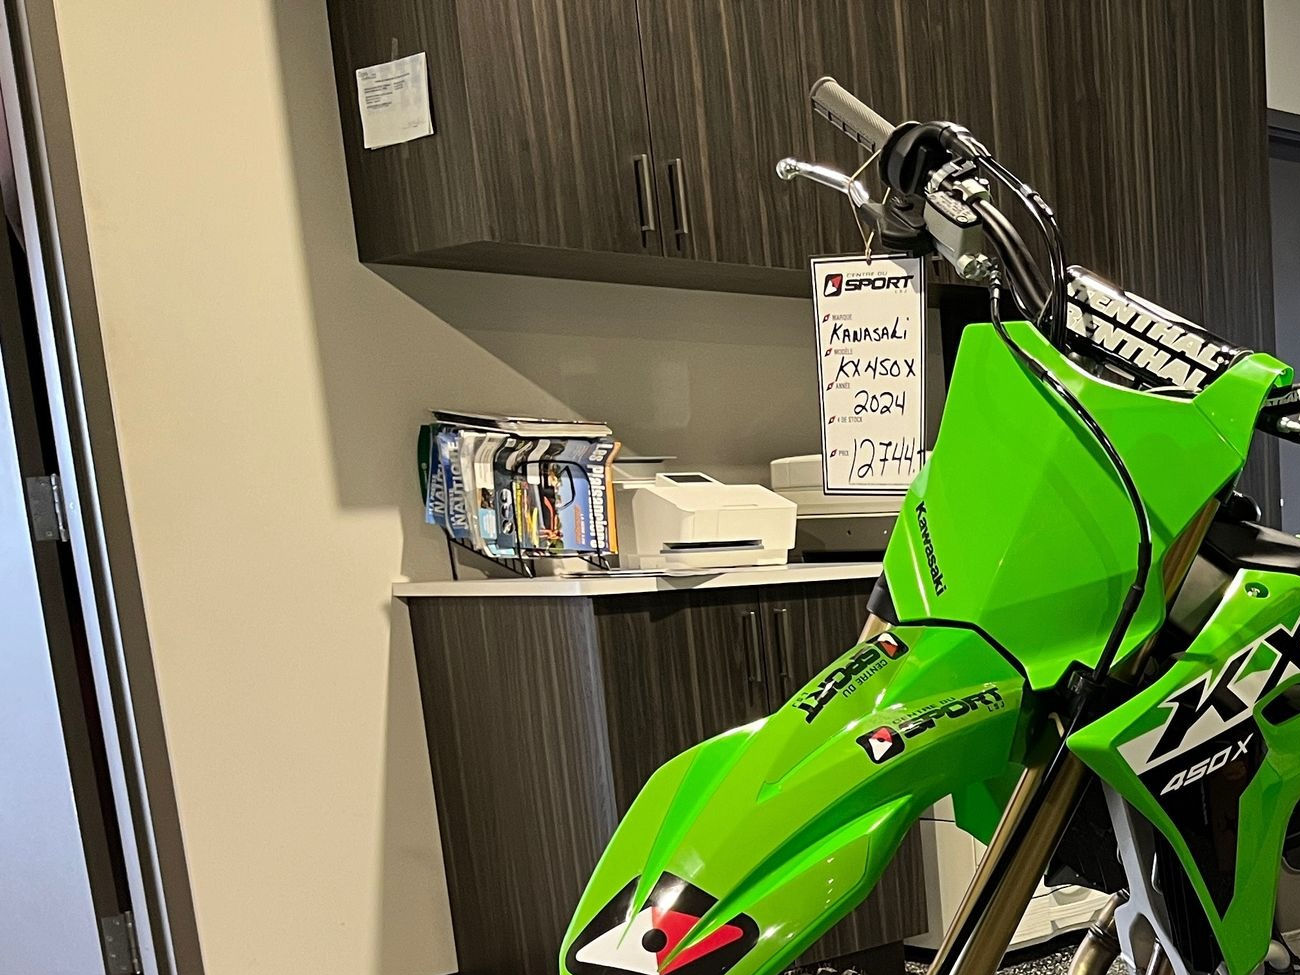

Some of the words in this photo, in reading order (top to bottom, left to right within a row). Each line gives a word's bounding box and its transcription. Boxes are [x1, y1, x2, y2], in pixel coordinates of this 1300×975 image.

[844, 275, 915, 291] SPORT
[853, 390, 906, 416] 2024
[915, 500, 947, 597] Kawasaki
[856, 659, 888, 685] CENTRE
[797, 648, 881, 724] SPORT
[842, 683, 857, 698] DU
[898, 687, 1003, 739] SPORT
